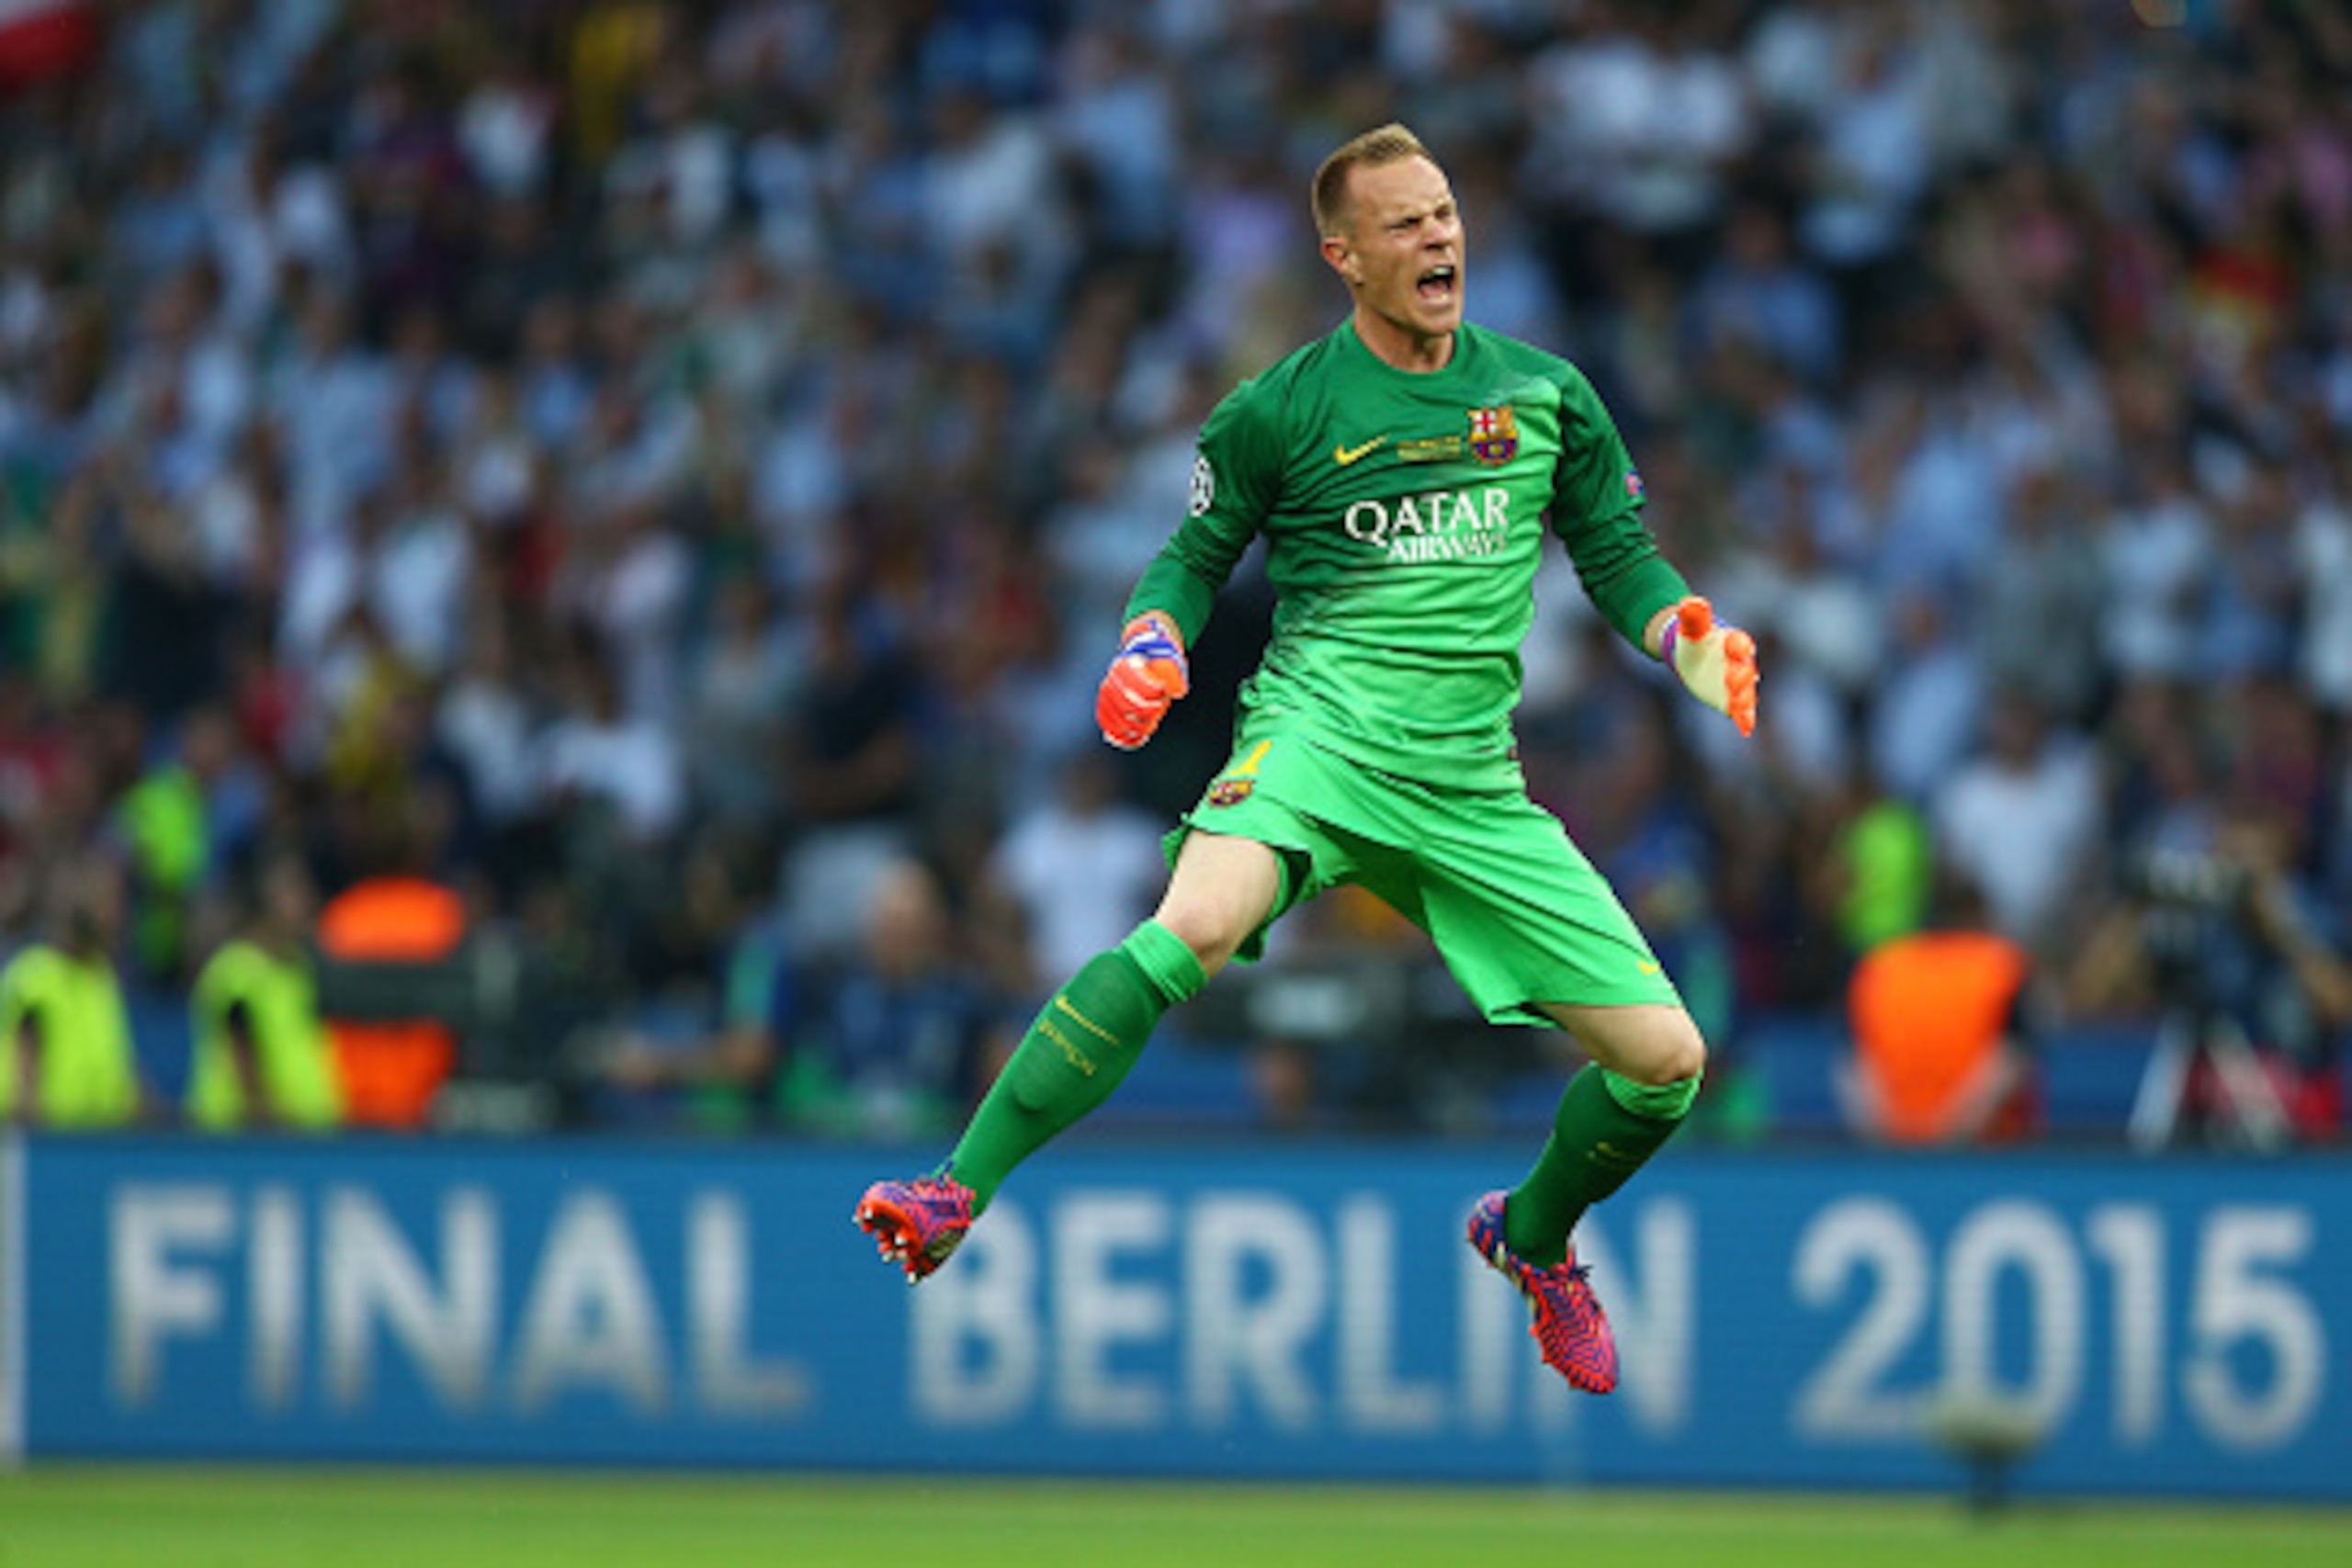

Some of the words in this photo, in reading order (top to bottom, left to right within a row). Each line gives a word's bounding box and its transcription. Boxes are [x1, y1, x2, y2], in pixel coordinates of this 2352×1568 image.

[1343, 487, 1510, 548] QATAR
[110, 1183, 812, 1418] FINAL
[911, 1189, 1696, 1435] BERLIN
[1792, 1196, 2326, 1453] 2015
